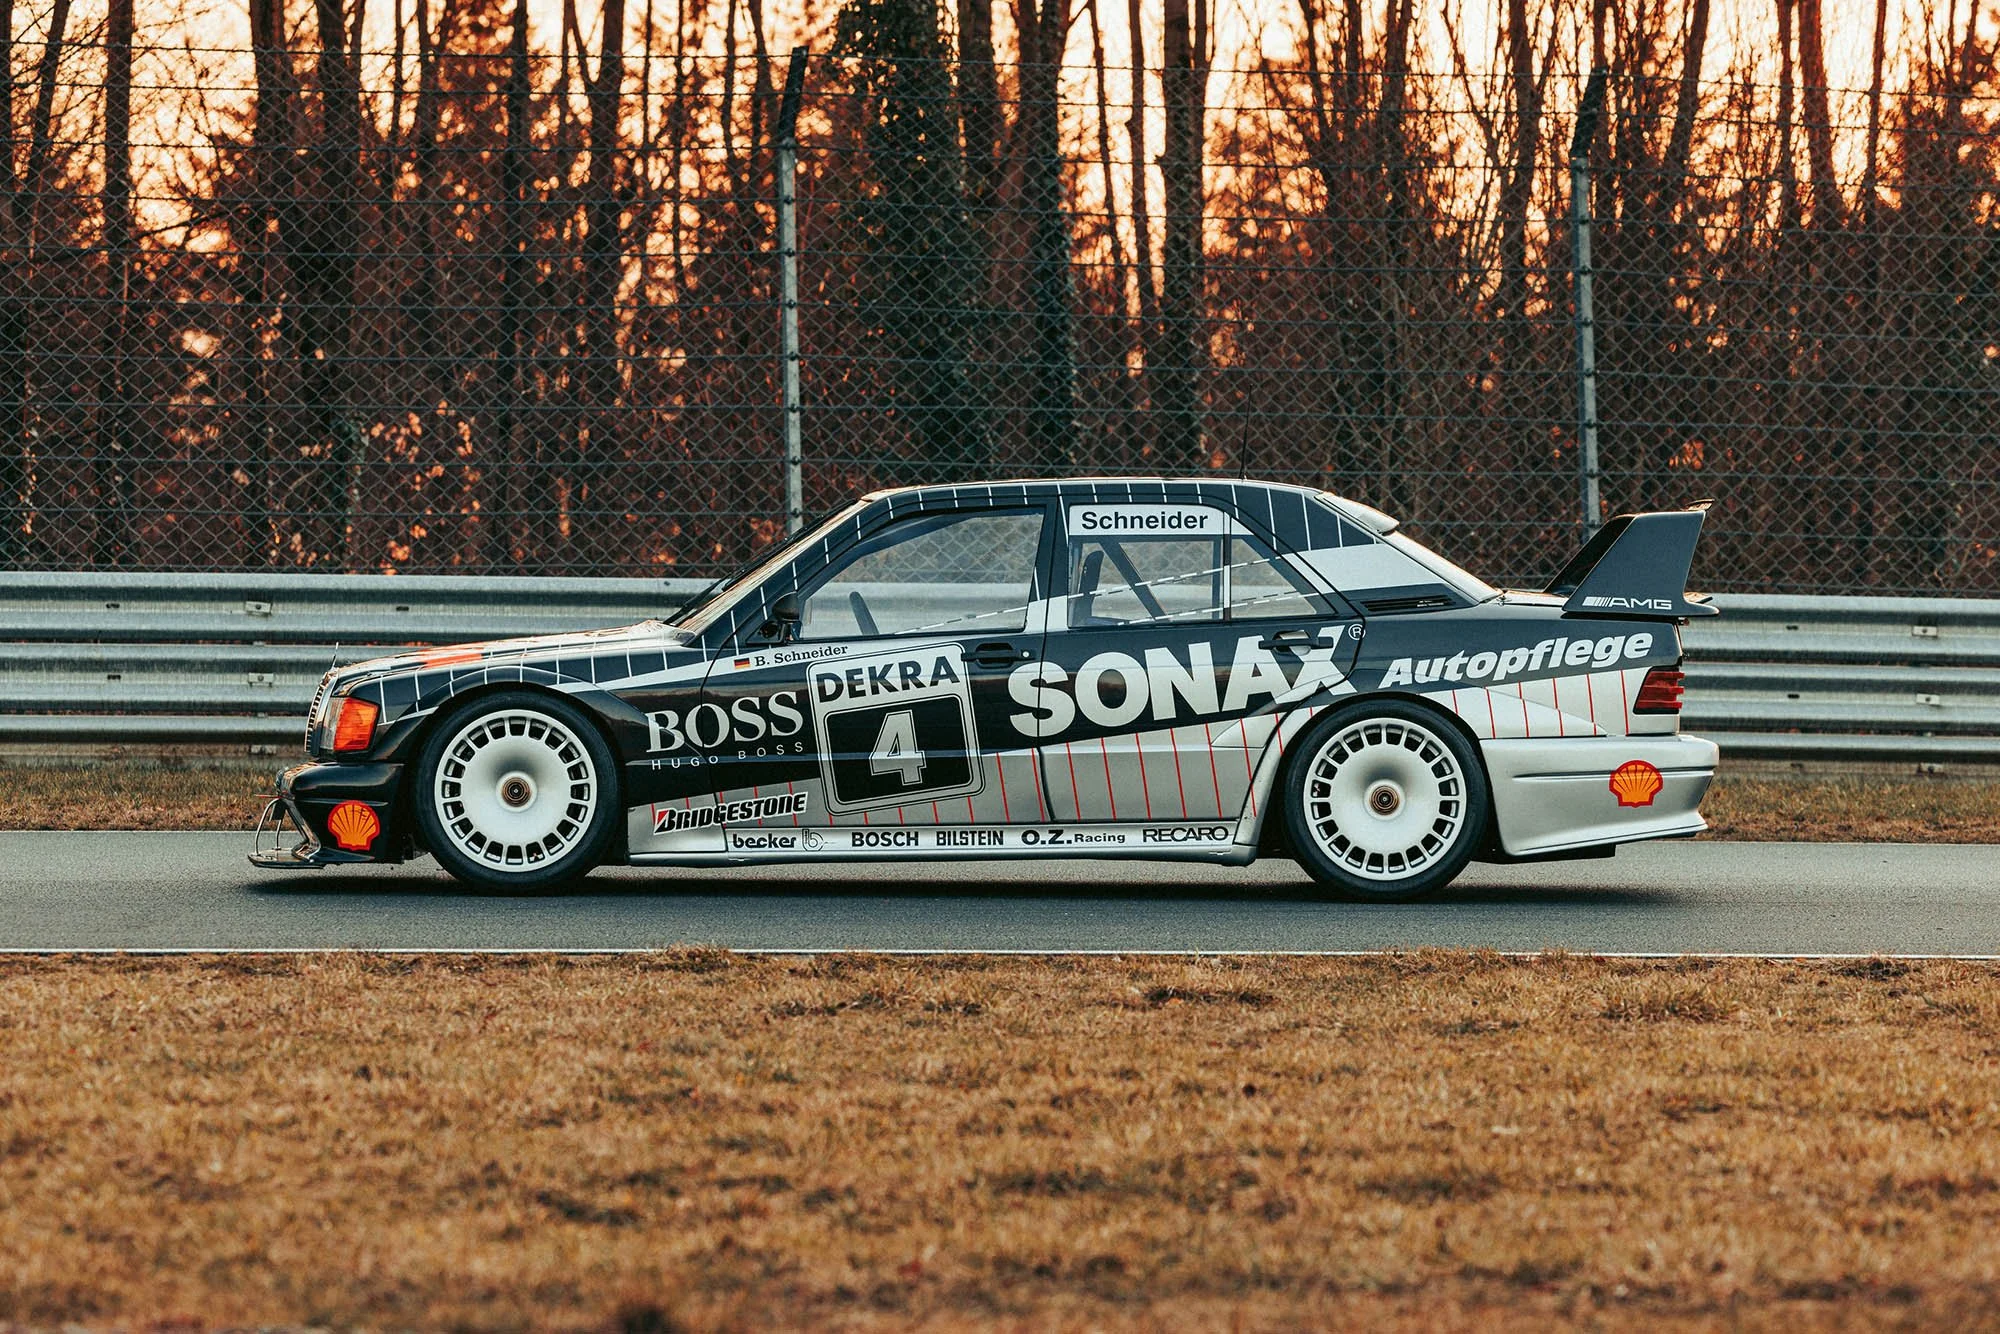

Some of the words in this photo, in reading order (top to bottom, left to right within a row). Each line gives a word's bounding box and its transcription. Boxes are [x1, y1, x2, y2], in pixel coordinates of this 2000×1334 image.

[1081, 511, 1209, 531] Schneider
[1608, 597, 1672, 610] AMG
[754, 656, 770, 667] B.
[774, 644, 848, 663] Schneider
[1378, 632, 1653, 690] Autopflege
[816, 656, 961, 703] DEKRA
[1007, 625, 1357, 737] SONAX
[646, 691, 804, 753] BOSS
[651, 754, 719, 770] HUGO
[738, 741, 804, 760] BOSS
[870, 709, 927, 786] 4
[653, 792, 808, 834] BRIDGESTONE
[732, 833, 797, 849] becker
[851, 831, 919, 847] BOSCH
[936, 830, 1004, 846] BILSTEIN
[1021, 829, 1073, 845] O.Z.
[1074, 831, 1126, 844] Racing
[1143, 826, 1229, 843] RECARO
